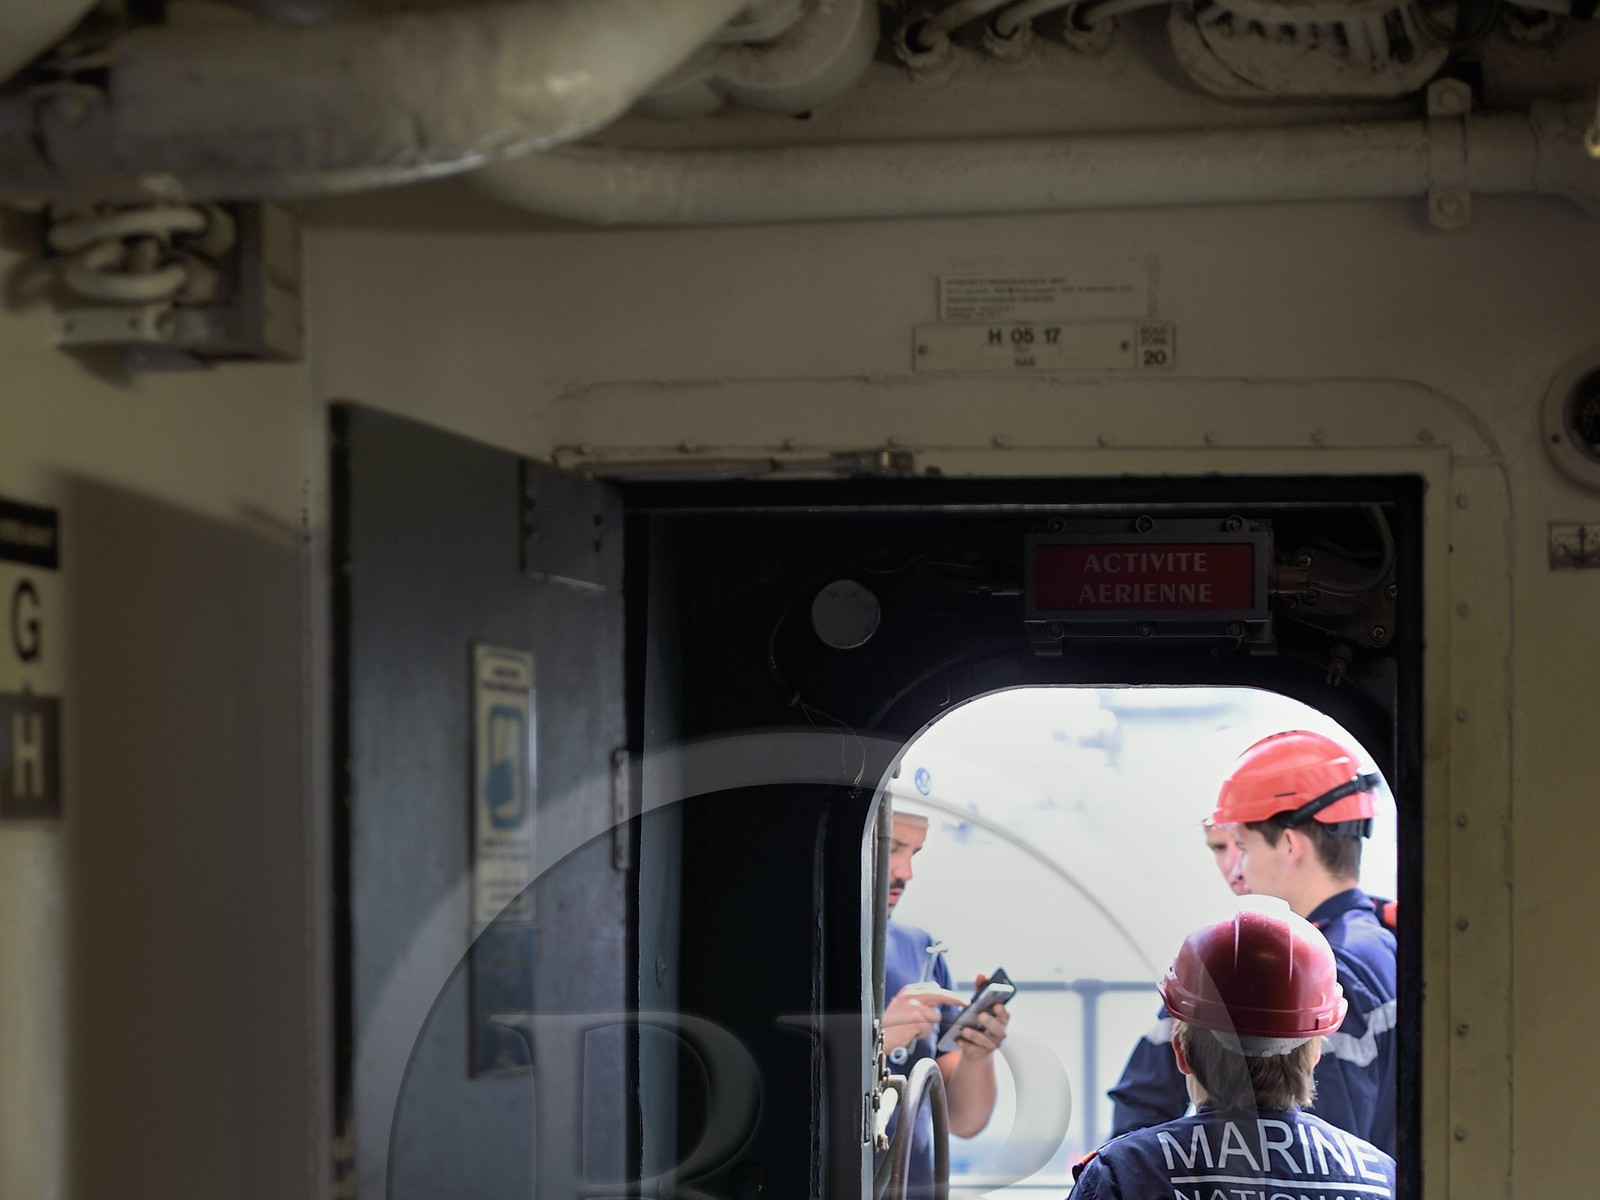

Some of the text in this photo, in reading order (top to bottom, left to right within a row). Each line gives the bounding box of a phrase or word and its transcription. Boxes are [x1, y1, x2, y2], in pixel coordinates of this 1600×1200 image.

[988, 327, 1061, 344] H 05 17
[1144, 350, 1167, 365] 20
[1083, 552, 1207, 573] ACTIVITE
[1079, 583, 1213, 604] AERIENNE
[10, 577, 40, 663] G
[12, 711, 43, 797] H
[1156, 1118, 1388, 1184] MARINE
